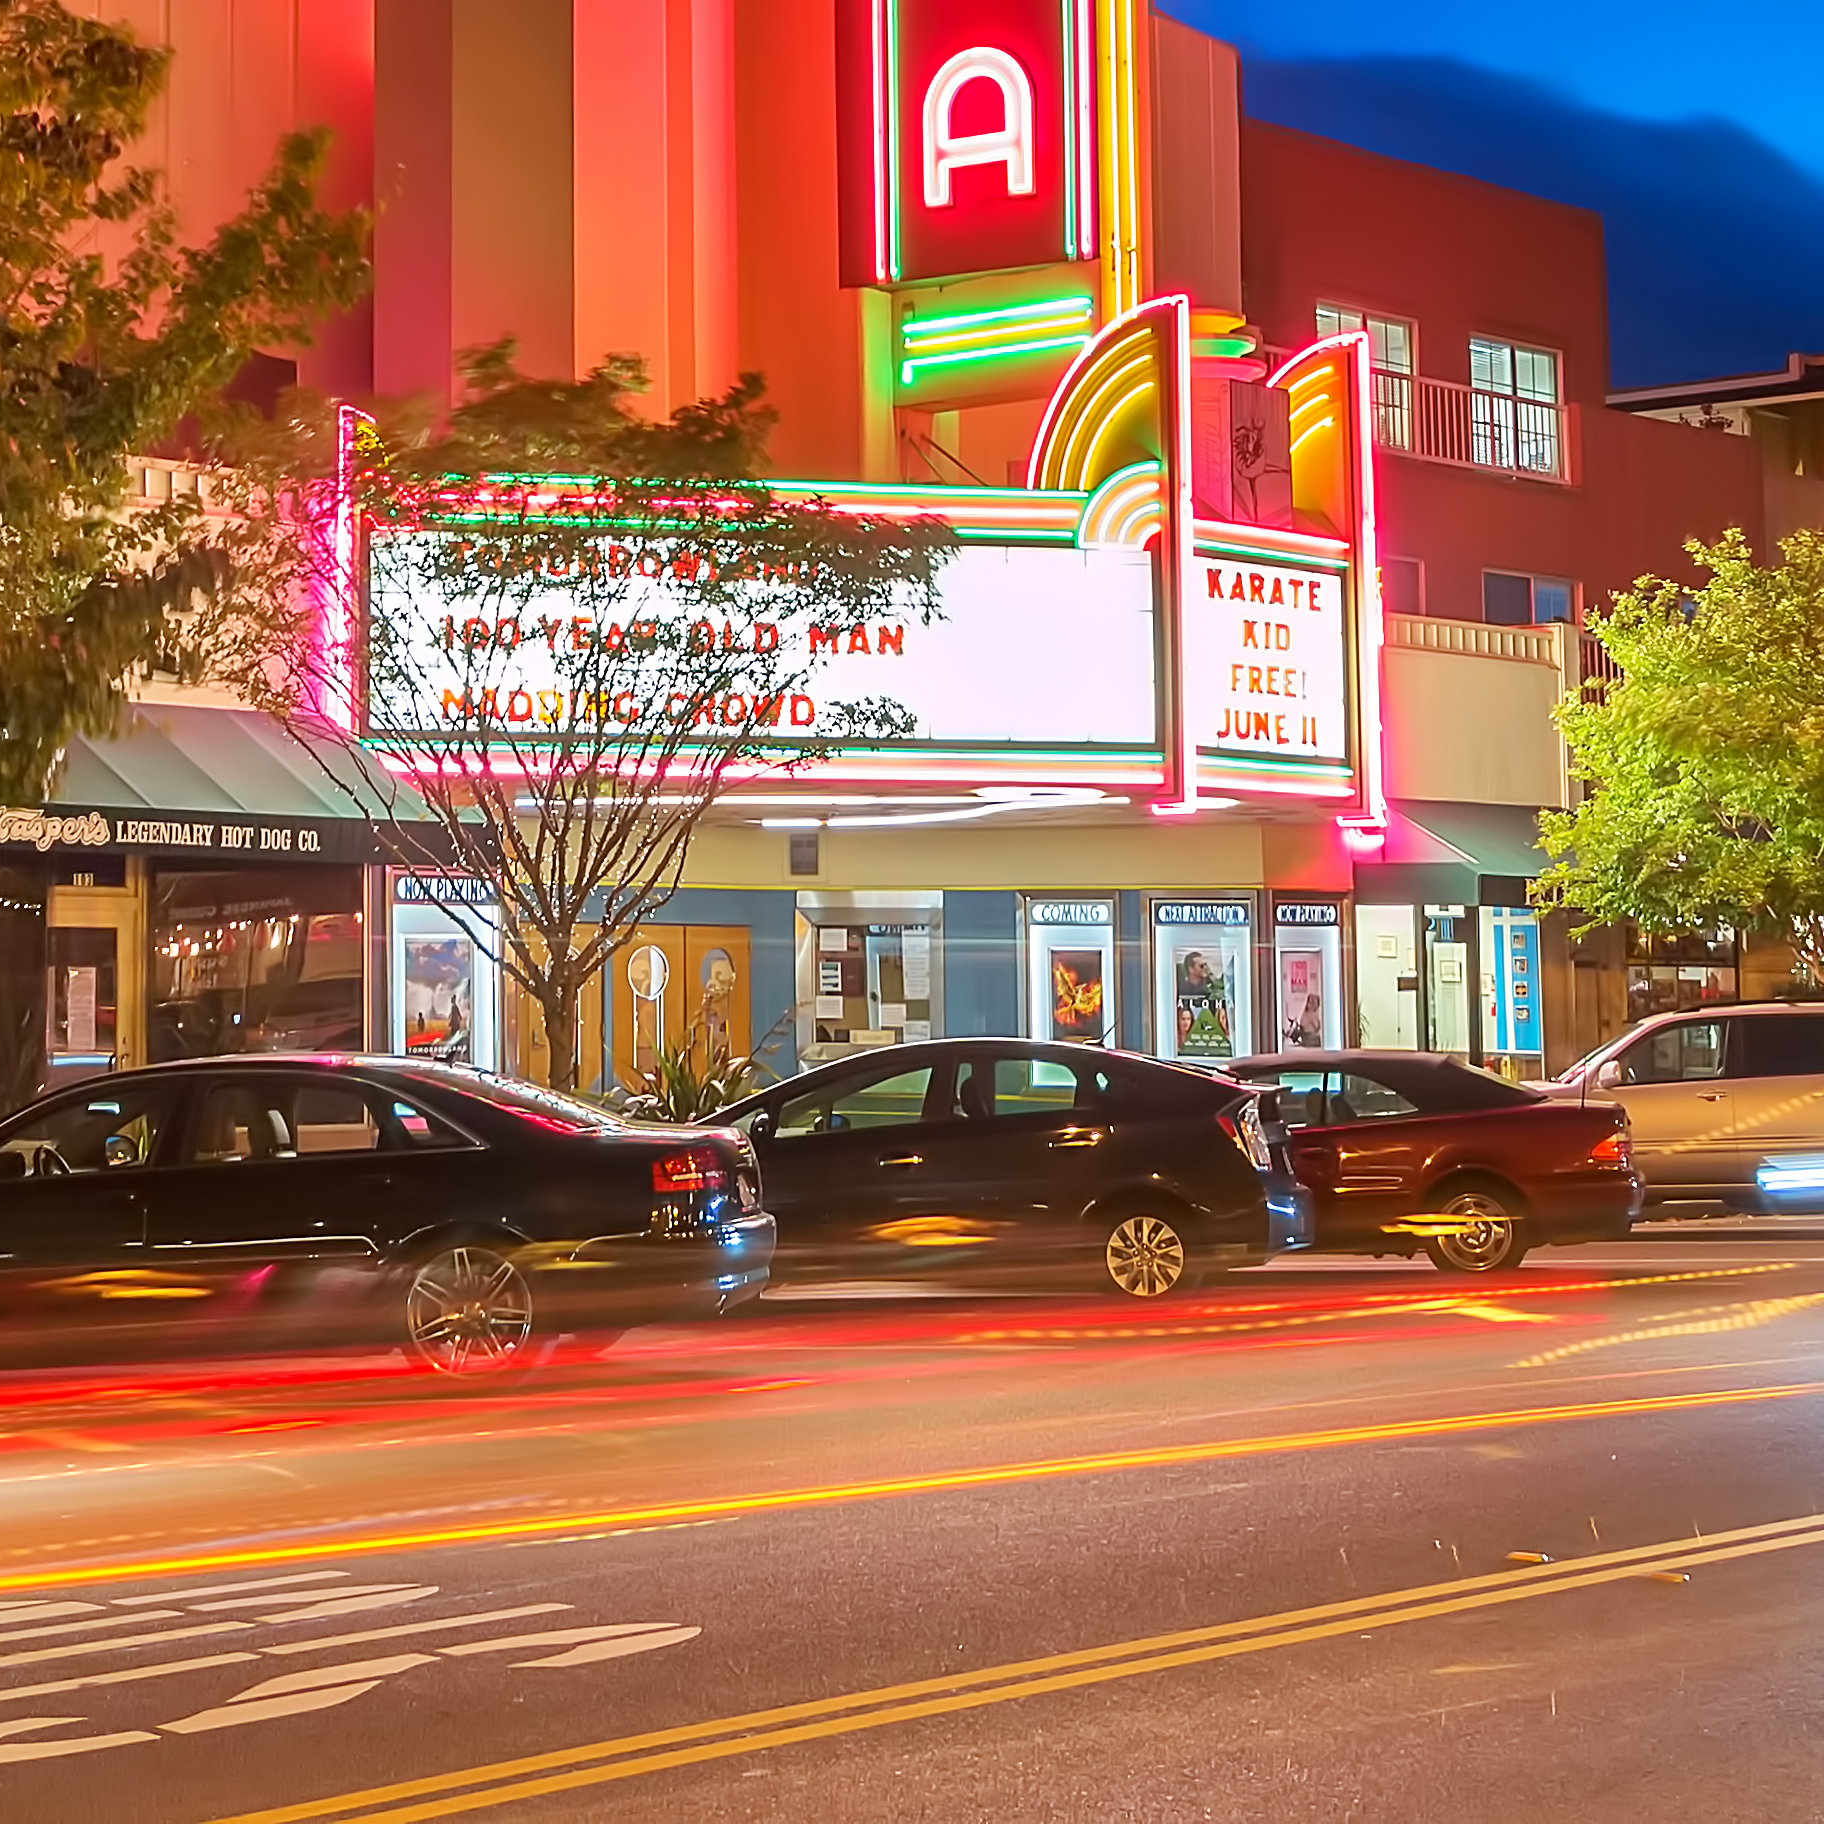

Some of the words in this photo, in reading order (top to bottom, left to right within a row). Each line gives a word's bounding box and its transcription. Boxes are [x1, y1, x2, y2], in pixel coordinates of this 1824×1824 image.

[1207, 568, 1321, 611] KARATE
[809, 622, 905, 656] MAN
[1243, 619, 1290, 651] KID
[1231, 663, 1307, 700] FREE!
[1217, 707, 1289, 745] JUNE
[116, 820, 214, 846] LEGENDARY
[221, 825, 254, 849] HOT
[260, 827, 292, 851] DOG
[298, 829, 321, 852] CO.
[404, 877, 432, 900] NOW
[437, 878, 490, 902] PLAYING
[1041, 905, 1100, 923] COMING
[1165, 905, 1183, 923] NEXT
[1177, 998, 1234, 1009] ALOHA
